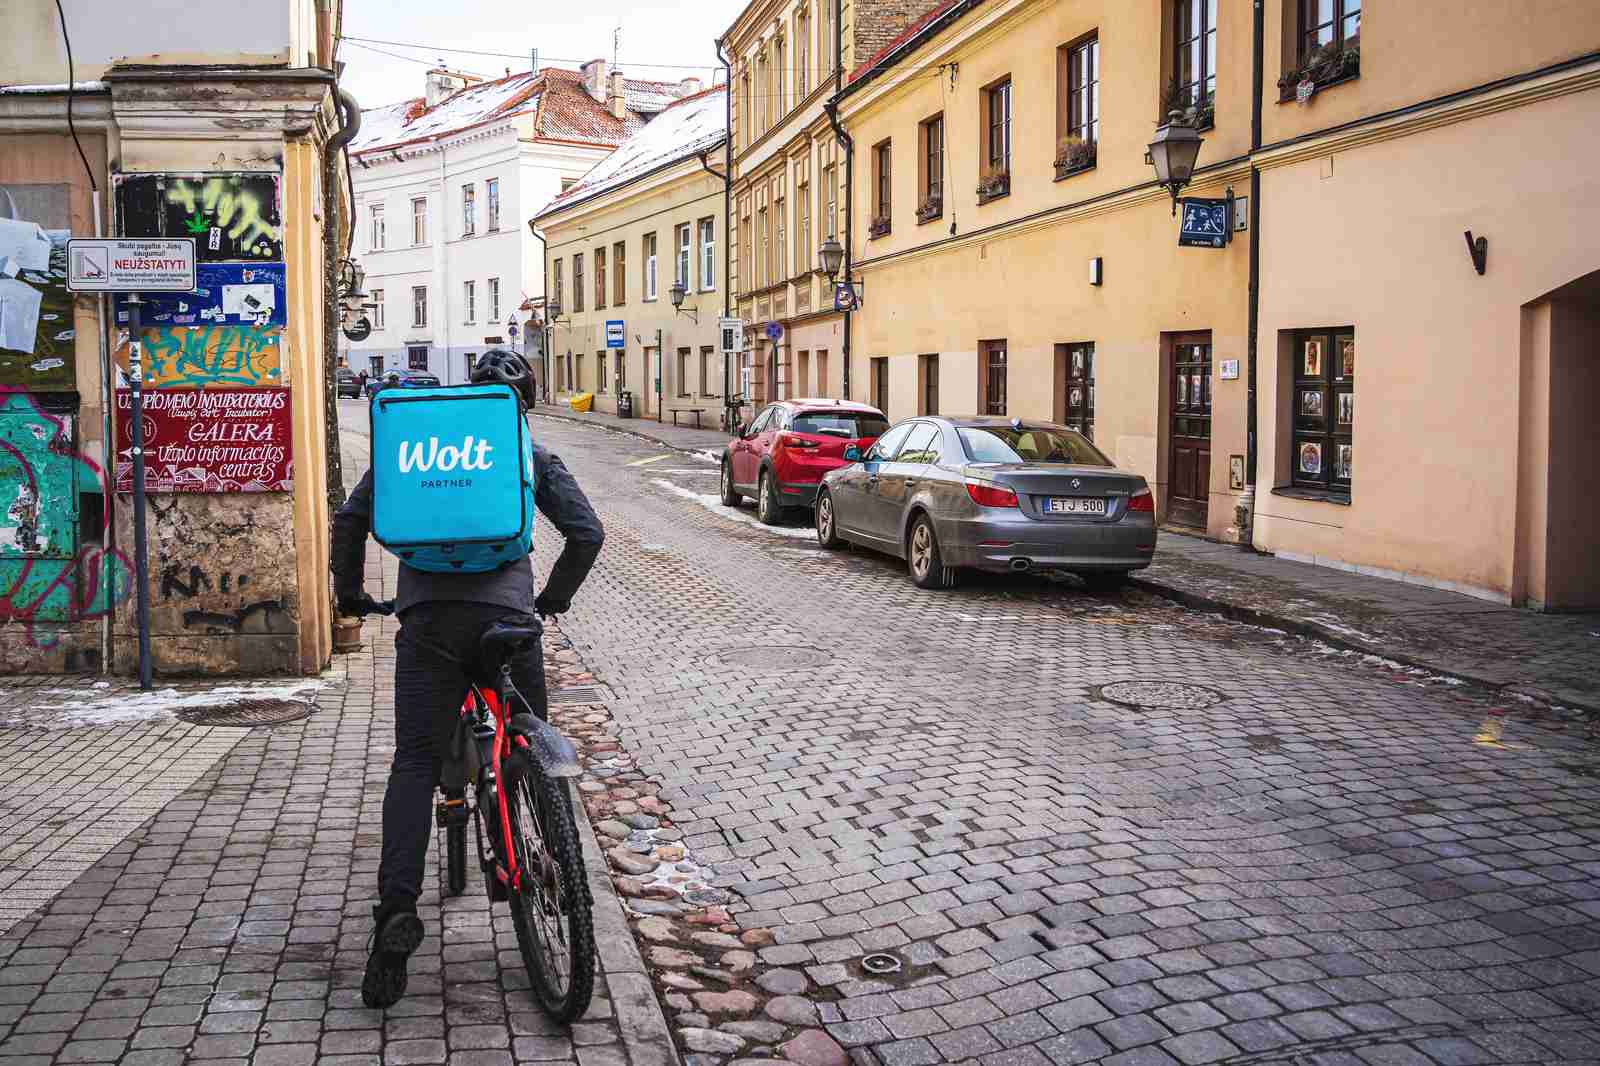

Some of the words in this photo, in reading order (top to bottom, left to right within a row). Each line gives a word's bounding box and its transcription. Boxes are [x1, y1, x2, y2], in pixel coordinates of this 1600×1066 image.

[114, 257, 186, 270] NEUŽSTATYTI
[188, 422, 275, 442] GALERA
[197, 444, 285, 466] informacijos
[398, 435, 494, 474] Wolt
[219, 461, 276, 483] centras
[420, 478, 473, 489] PARTNER
[1050, 499, 1075, 511] ETJ
[1083, 499, 1103, 511] 500
